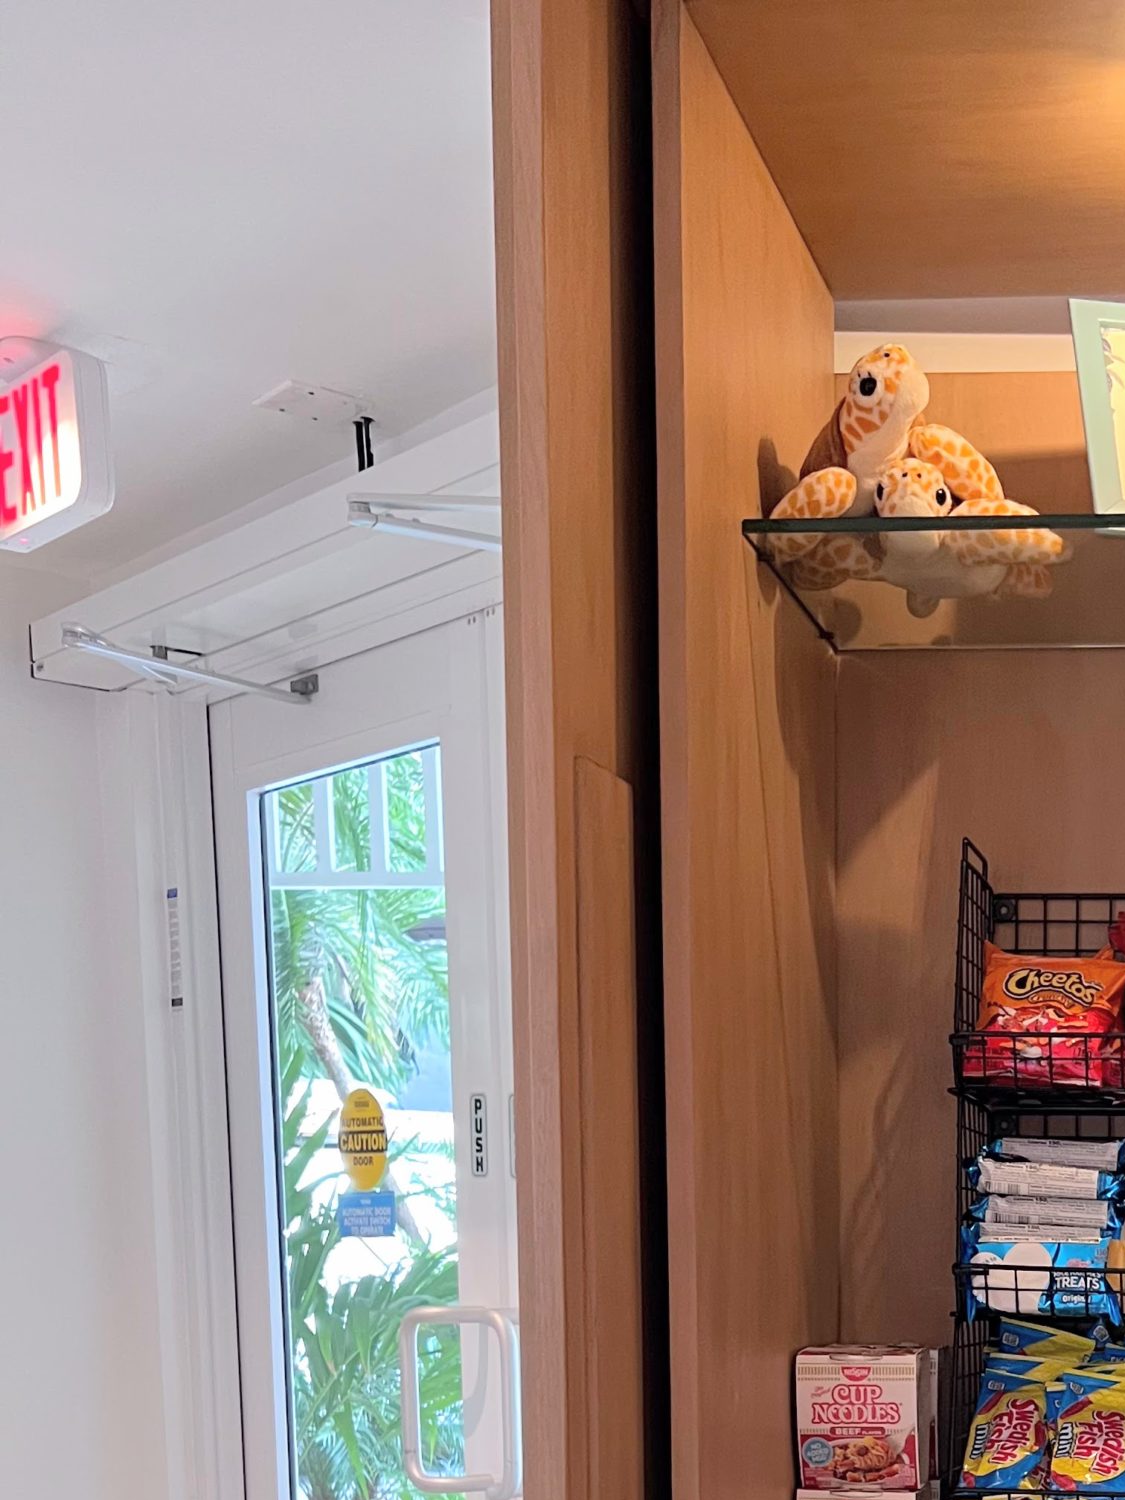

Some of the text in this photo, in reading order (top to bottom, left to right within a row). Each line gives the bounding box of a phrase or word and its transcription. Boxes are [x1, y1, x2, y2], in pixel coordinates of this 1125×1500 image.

[0, 364, 61, 527] EXIT
[1007, 969, 1095, 1004] Cheetos
[341, 1116, 384, 1128] AUTOMATIC
[474, 1098, 484, 1172] PUSH
[340, 1132, 387, 1151] CAUTION
[353, 1155, 374, 1166] DOOR
[1055, 1277, 1100, 1289] TREATS
[1062, 1292, 1092, 1303] originl
[832, 1384, 882, 1404] CUP
[812, 1403, 901, 1424] NOODLES
[989, 1398, 1040, 1464] Swedish
[835, 1427, 862, 1436] BEEF
[969, 1422, 990, 1460] mini
[985, 1411, 1014, 1452] Fish
[1055, 1422, 1074, 1459] mini
[1073, 1422, 1104, 1459] Fish
[1090, 1410, 1125, 1476] Swedish
